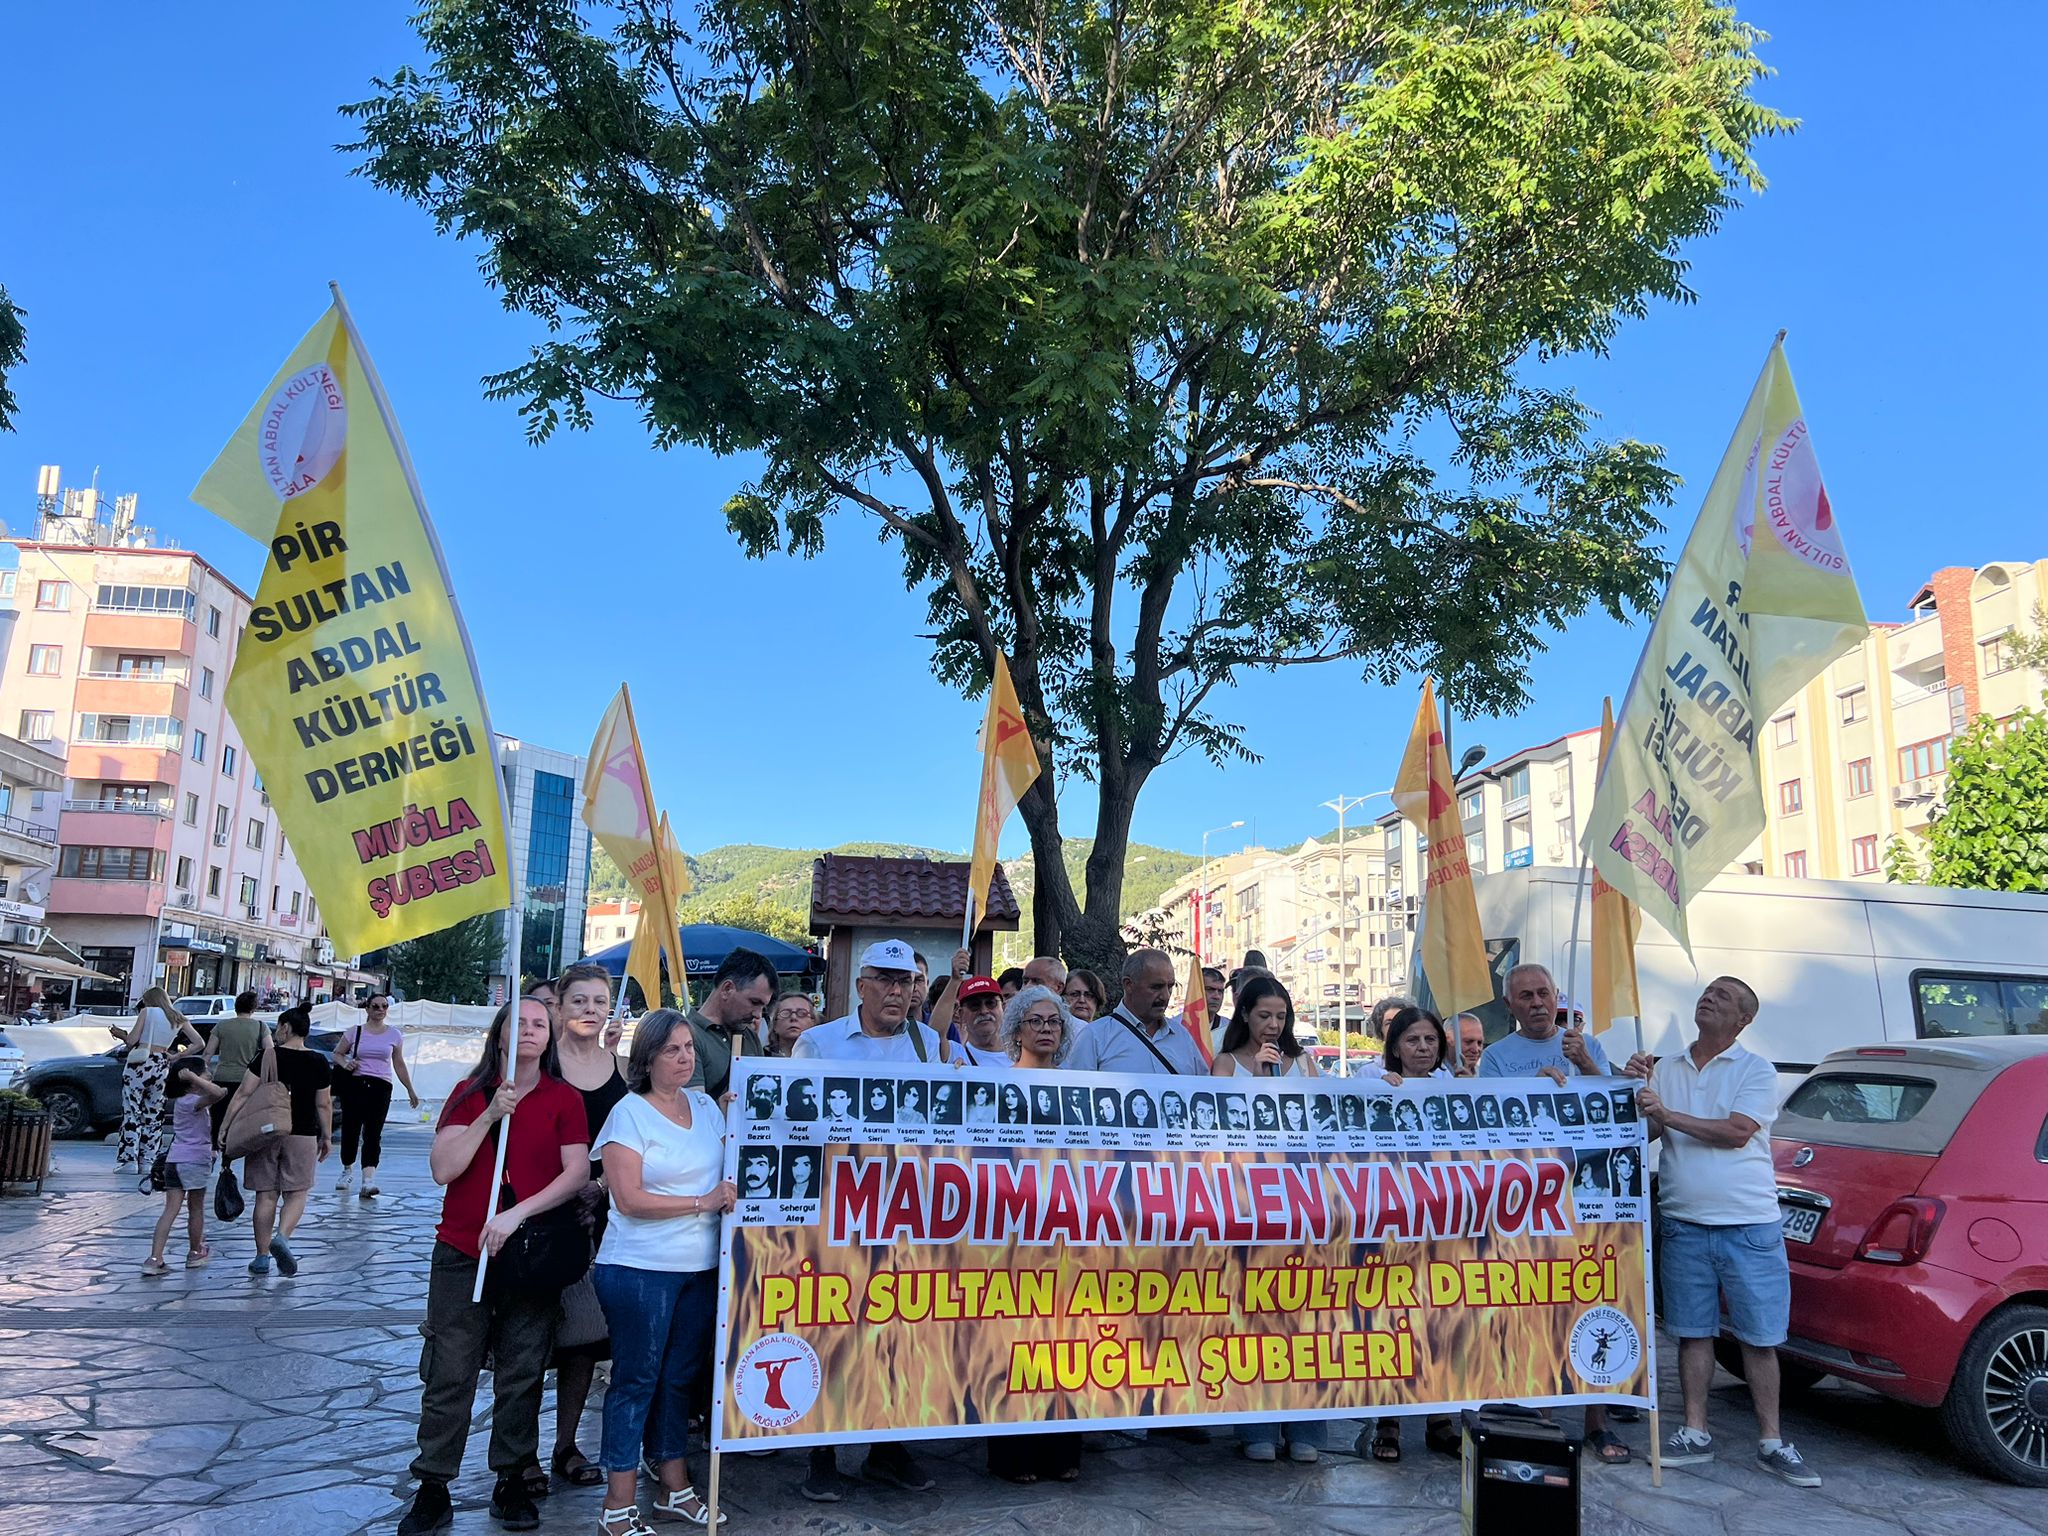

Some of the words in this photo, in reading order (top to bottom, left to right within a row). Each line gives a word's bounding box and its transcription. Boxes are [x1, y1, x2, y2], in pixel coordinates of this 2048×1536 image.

[265, 403, 290, 452] ABDAL
[1771, 420, 1808, 471] KÜLTÜ
[267, 456, 289, 493] LTAN
[1768, 475, 1791, 528] ABDAL
[271, 520, 348, 573] PİR
[1784, 529, 1844, 570] SULTAN
[250, 561, 412, 643] SULTAN
[287, 621, 421, 694] ABDAL
[292, 672, 447, 749] KÜLTÜR
[304, 714, 476, 803] DERNEĞİ
[352, 797, 482, 865] MUĞLA
[367, 839, 497, 919] ŞUBESİ
[742, 1215, 765, 1223] Metin
[829, 1155, 1129, 1247] MADIMAK
[1133, 1160, 1331, 1247] HALEN
[1327, 1157, 1573, 1244] YANIYOR
[760, 1257, 854, 1328] PİR
[864, 1268, 1057, 1323] SULTAN
[1065, 1268, 1230, 1316] ABDAL
[1244, 1251, 1420, 1313] KÜLTÜR
[1428, 1245, 1618, 1309] DERNEĞİ
[1007, 1323, 1190, 1394] MUĞLA
[1198, 1316, 1416, 1400] ŞUBELERİ
[1602, 1309, 1638, 1358] FEDERASYONU
[737, 1350, 755, 1380] SULTAN
[755, 1336, 780, 1353] ABDAL
[782, 1336, 809, 1353] KÜLTÜR
[807, 1353, 820, 1390] DERNEĞİ
[752, 1413, 781, 1427] MUĞLA
[783, 1410, 800, 1426] 2012
